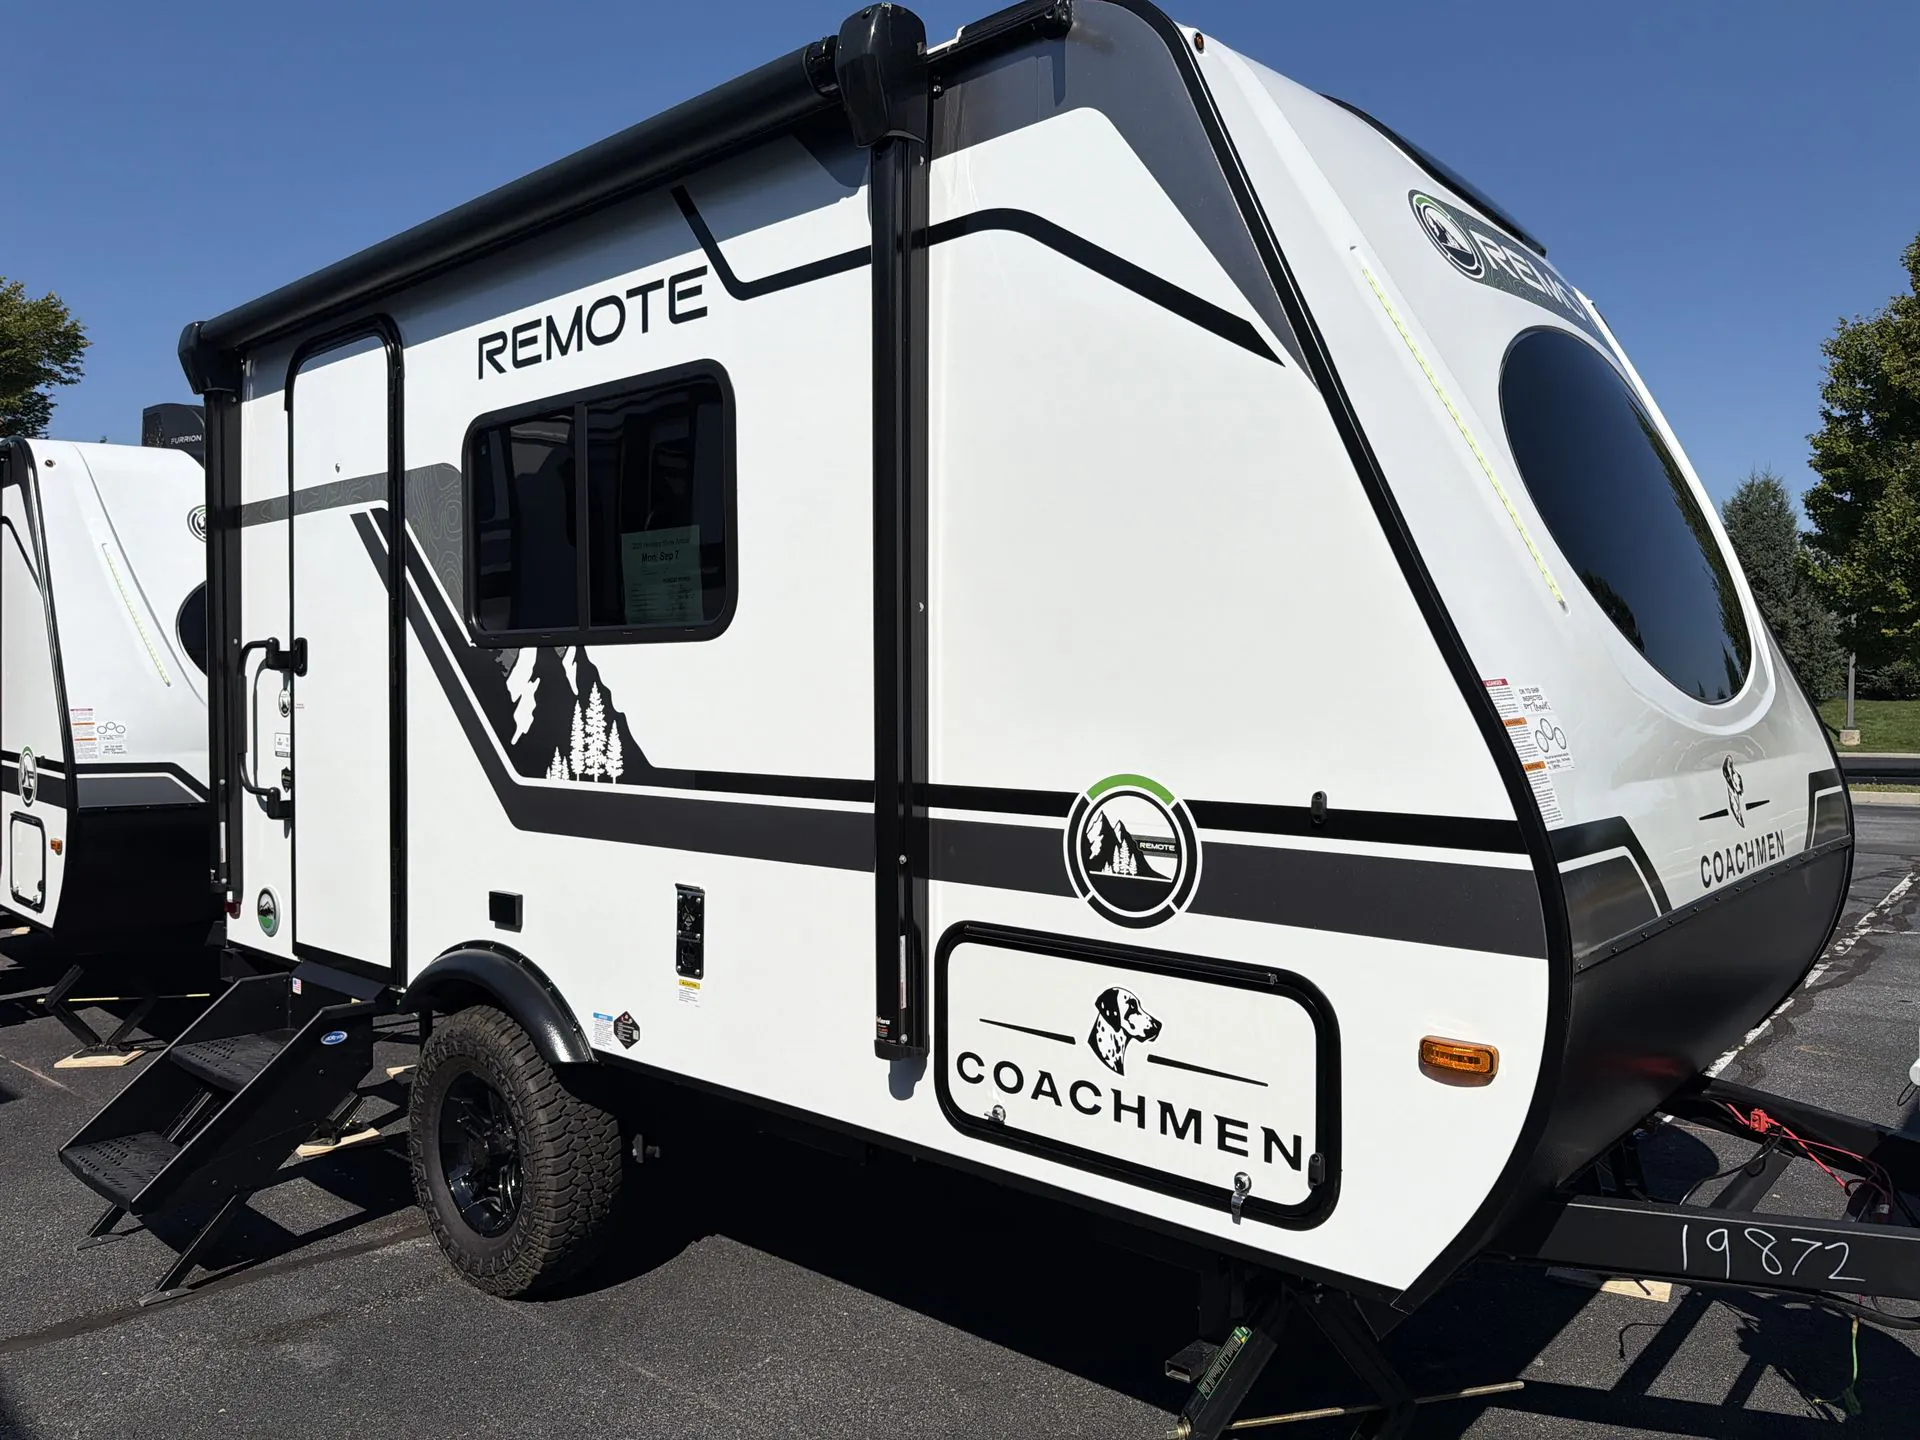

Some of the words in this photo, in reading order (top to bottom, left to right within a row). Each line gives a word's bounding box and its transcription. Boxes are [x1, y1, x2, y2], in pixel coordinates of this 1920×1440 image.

[1469, 230, 1599, 333] REMO
[478, 265, 707, 380] REMOTE
[170, 434, 202, 445] FURRION
[1139, 841, 1176, 851] REMOTE
[1700, 829, 1786, 888] COACHMEN
[956, 1051, 1303, 1172] COACHMEN
[1682, 1223, 1867, 1282] 19872
